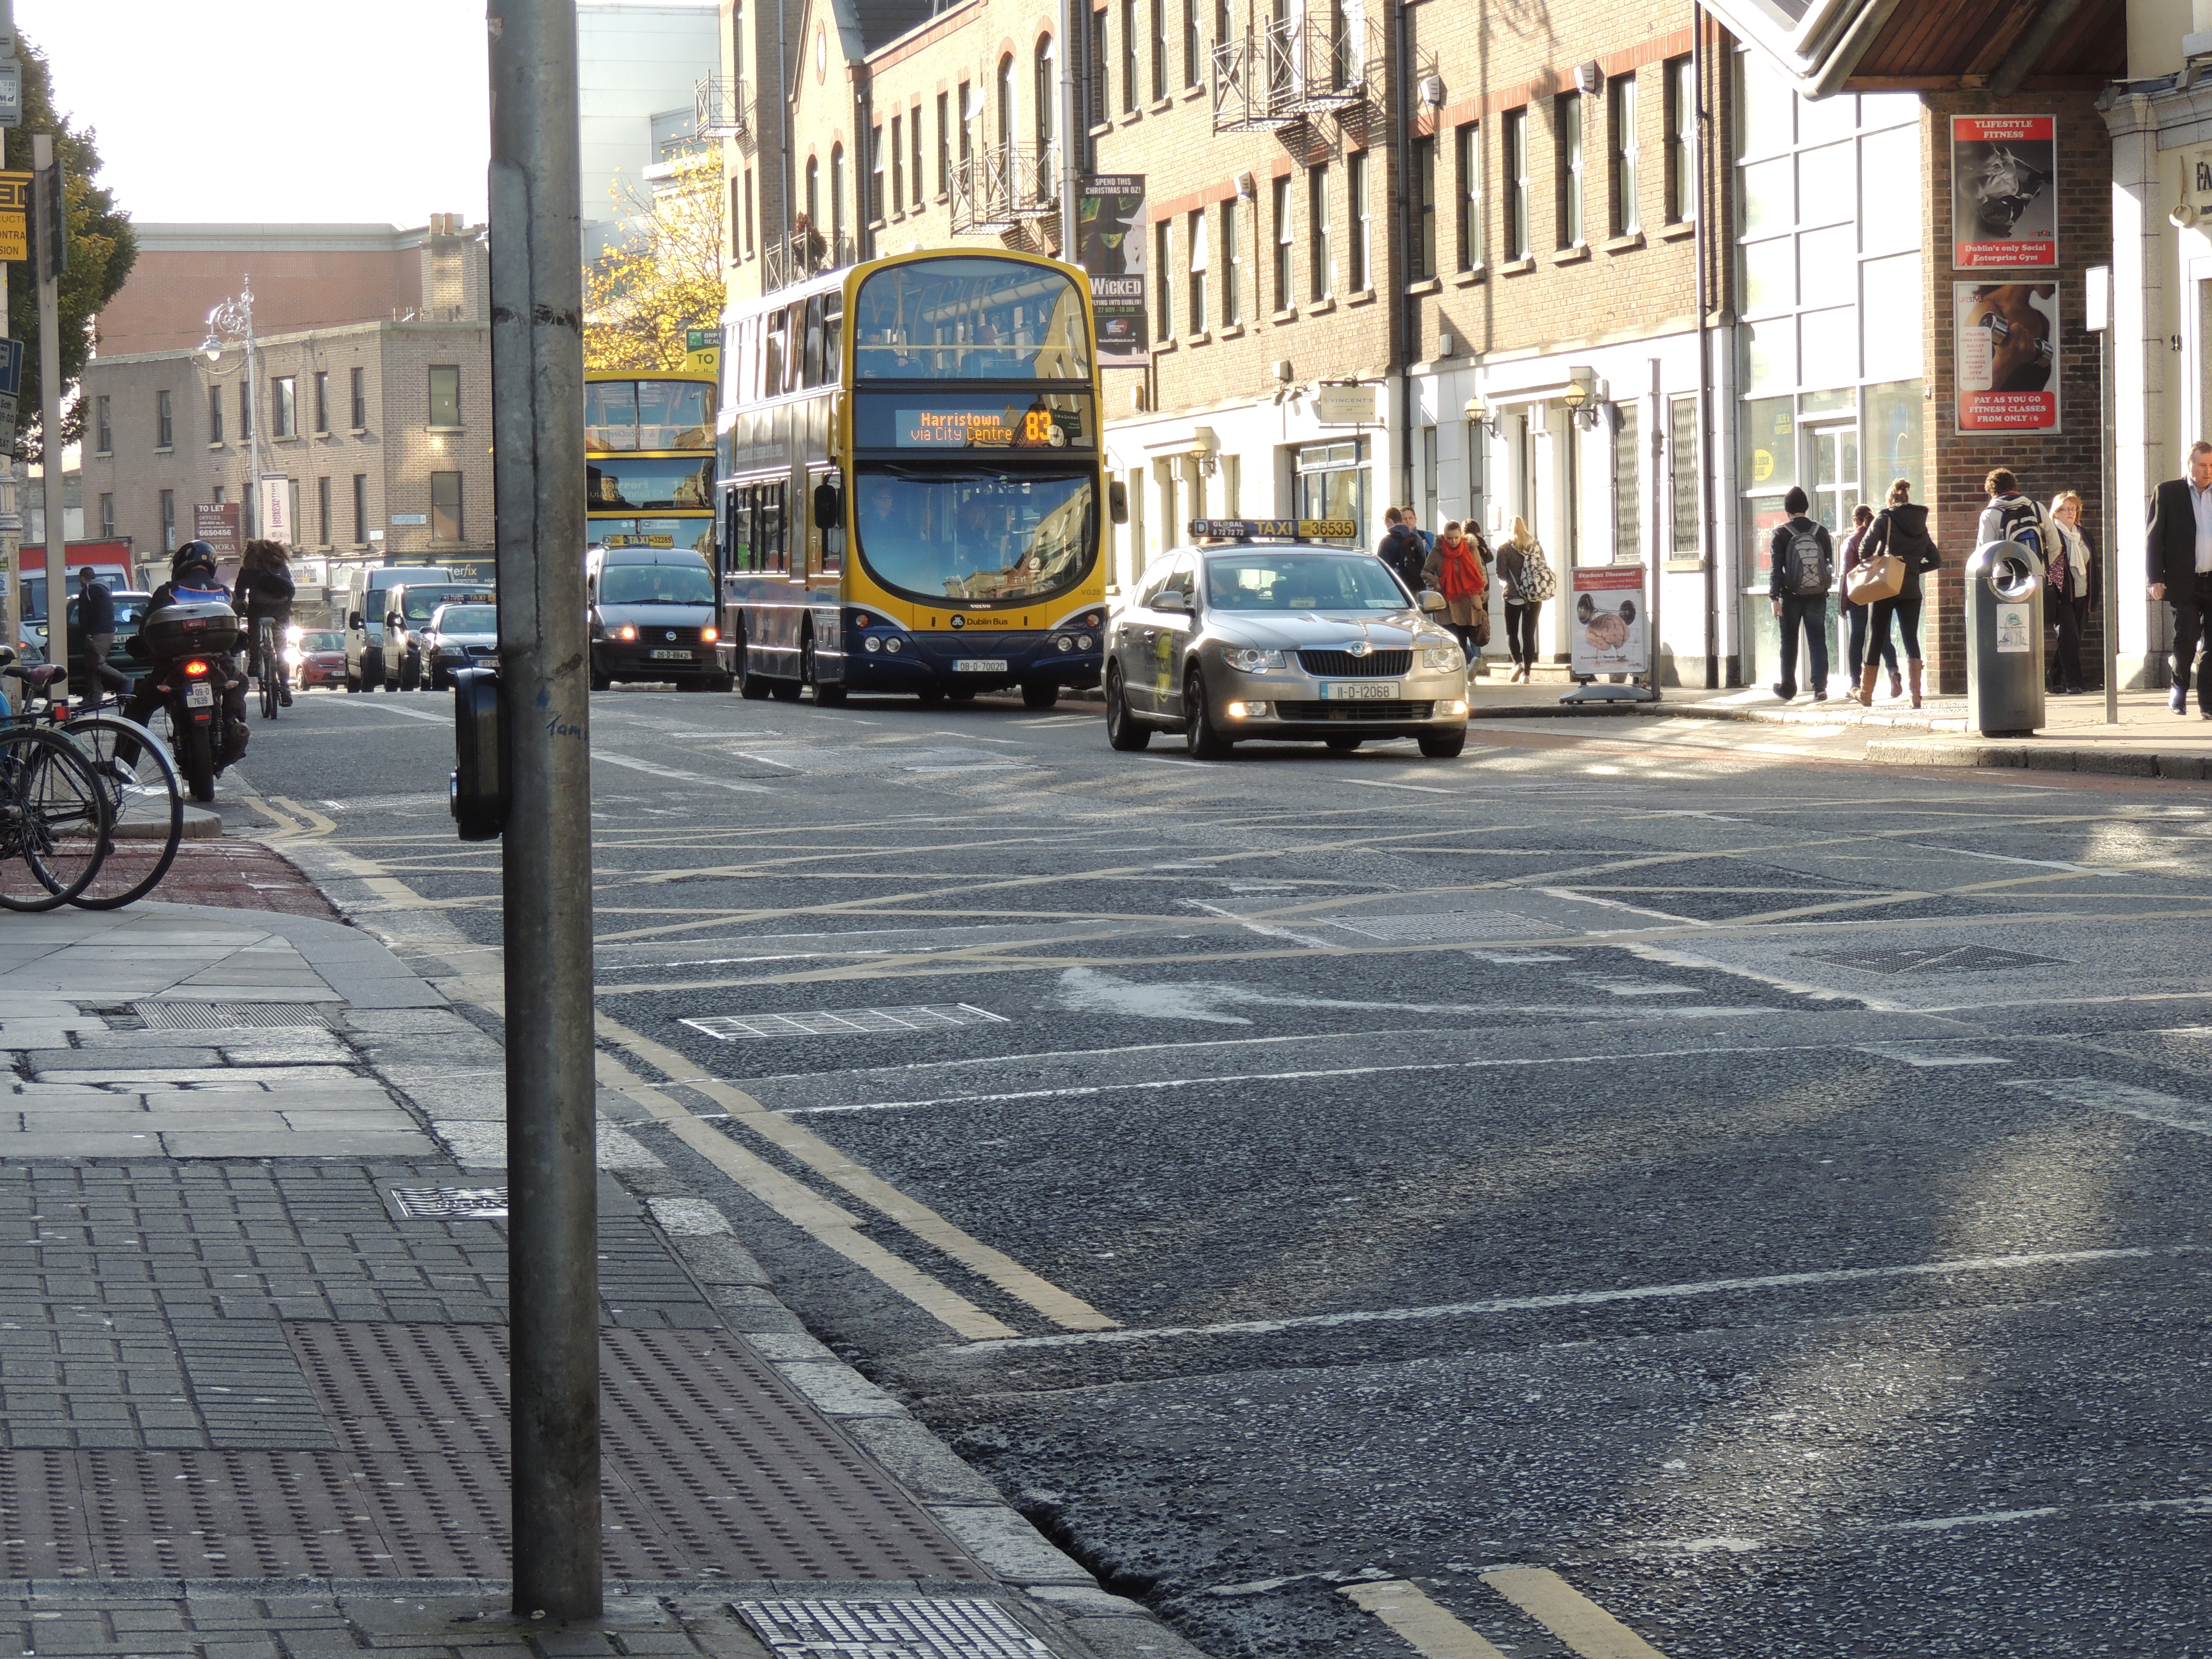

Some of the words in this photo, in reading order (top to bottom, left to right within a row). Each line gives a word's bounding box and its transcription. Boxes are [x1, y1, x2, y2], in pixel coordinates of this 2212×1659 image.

[1130, 186, 1141, 194] OZ!
[697, 353, 714, 364] TO
[921, 412, 1000, 426] Harristown
[1026, 411, 1051, 440] 83
[911, 427, 931, 441] via
[936, 427, 962, 441] City
[966, 427, 1012, 440] Centre
[1197, 522, 1206, 533] D
[1253, 521, 1293, 536] TAXI
[1311, 522, 1354, 535] 36535
[627, 536, 649, 544] TAXI
[960, 662, 1004, 671] 08-D-70020
[195, 687, 209, 696] 09-D
[1337, 685, 1390, 698] 11-D-12068
[193, 697, 208, 705] 7639
